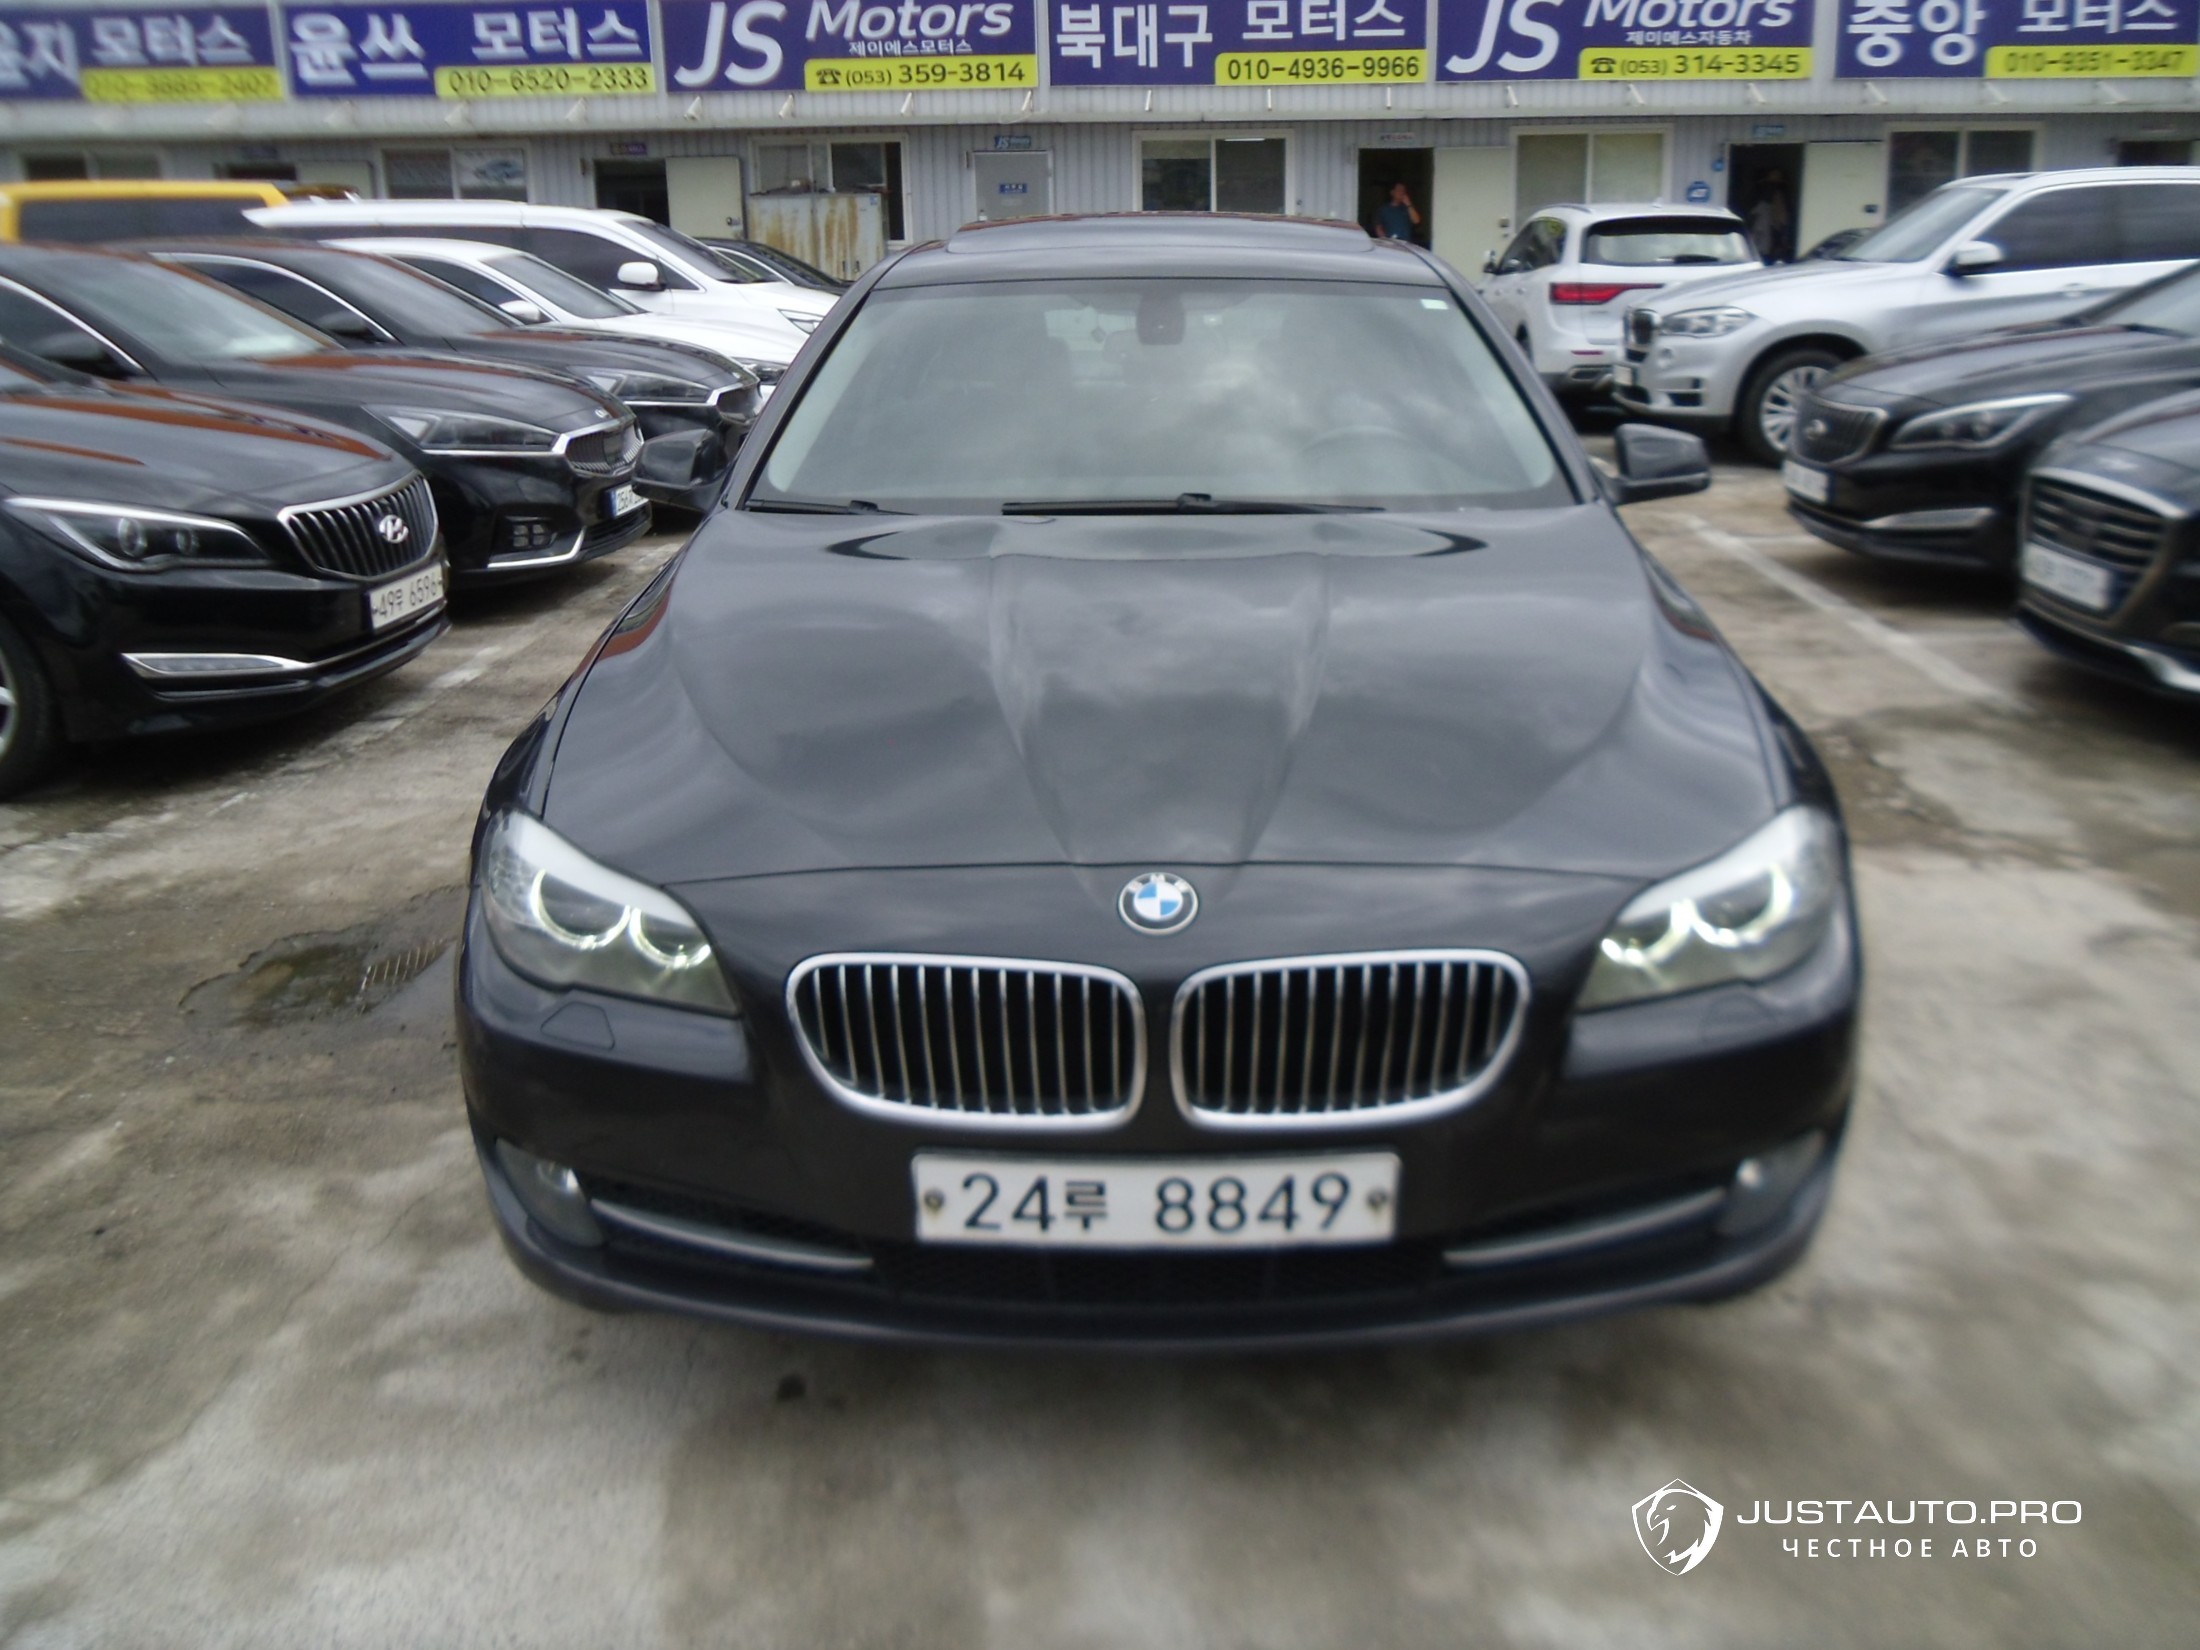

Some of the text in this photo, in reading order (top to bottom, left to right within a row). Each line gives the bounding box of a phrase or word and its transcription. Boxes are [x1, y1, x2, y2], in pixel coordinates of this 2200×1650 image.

[91, 14, 254, 66] 모터스
[289, 13, 428, 86] 윤쓰
[471, 8, 643, 60] 모터스
[674, 0, 1013, 87] JS Motors
[848, 38, 973, 57] 제이에스모터스
[1057, 0, 1405, 68] 북대구 모터스
[1444, 0, 1795, 74] JS Motors
[1847, 0, 2179, 67] 중앙 모터스
[449, 66, 648, 94] 010-6520-2333
[845, 62, 1025, 86] (053) 359-3814
[1228, 56, 1420, 80] 010-4936-9966
[1620, 54, 1801, 75] (053) 314-3345
[409, 573, 438, 607] 6596
[962, 1172, 1352, 1234] 24루 8849
